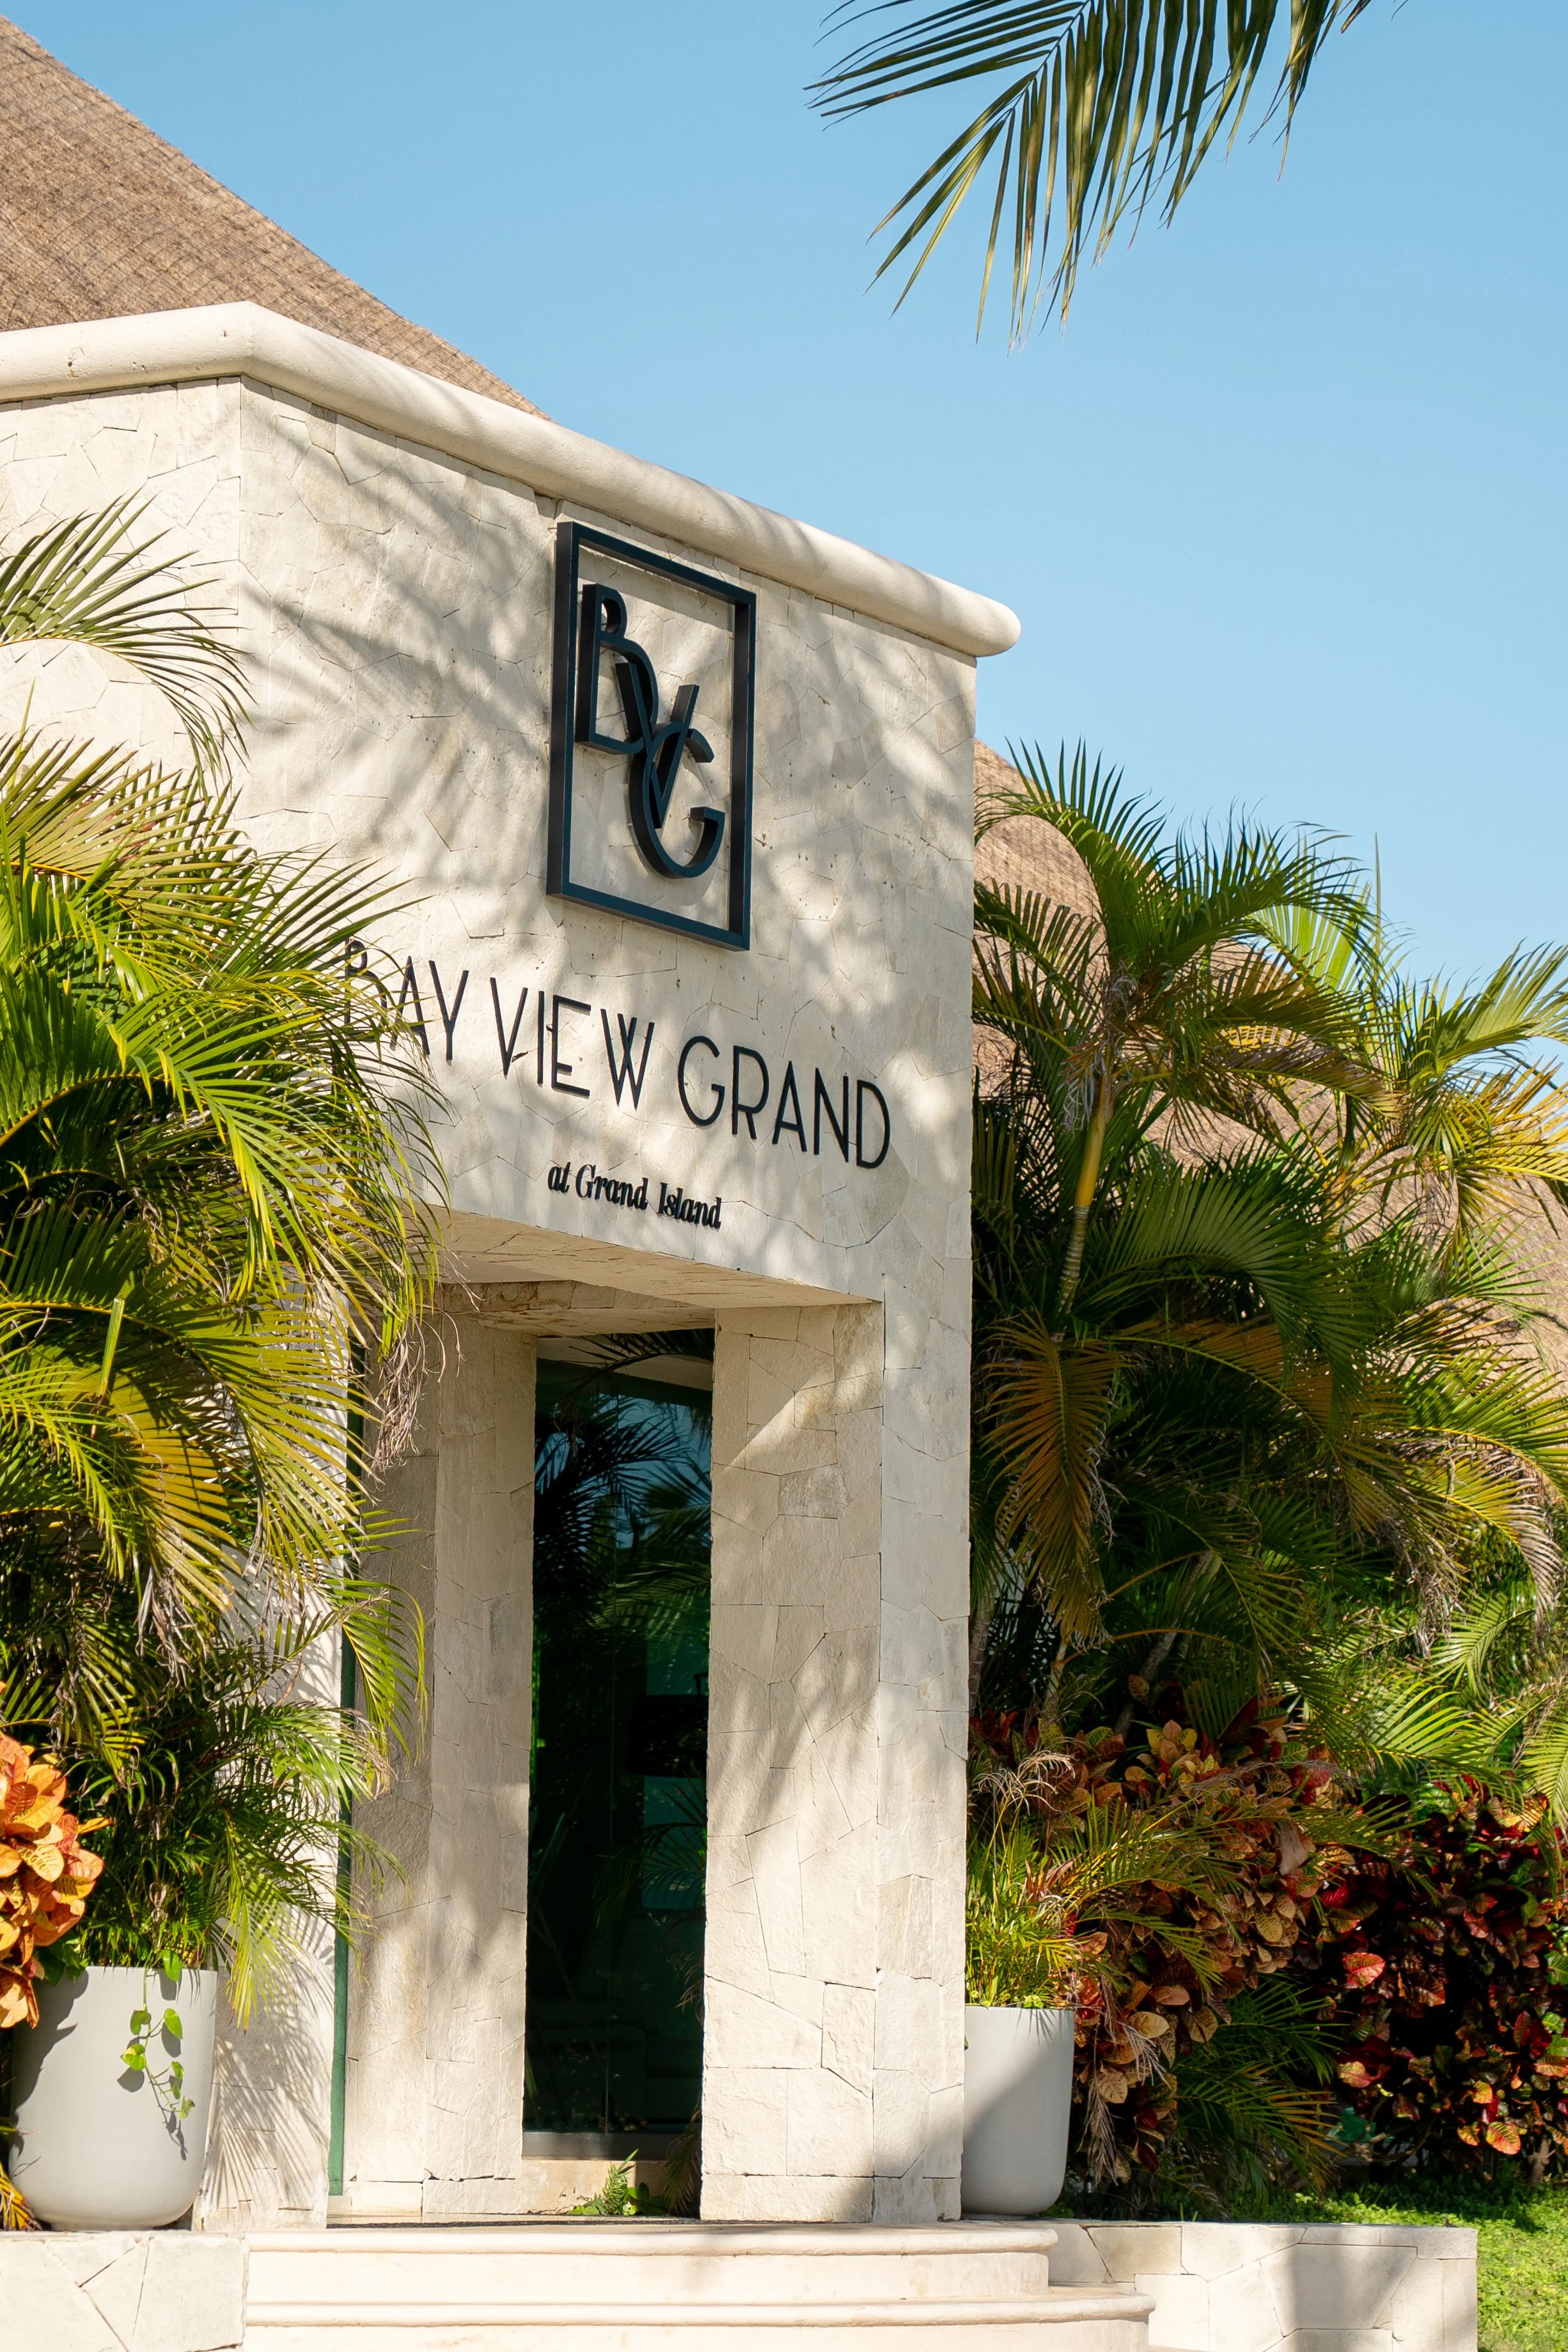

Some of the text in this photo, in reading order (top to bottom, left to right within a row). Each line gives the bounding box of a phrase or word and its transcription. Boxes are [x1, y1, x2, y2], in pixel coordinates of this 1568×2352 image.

[677, 1035, 891, 1169] GRAND
[547, 1161, 722, 1230] at Grand Island
